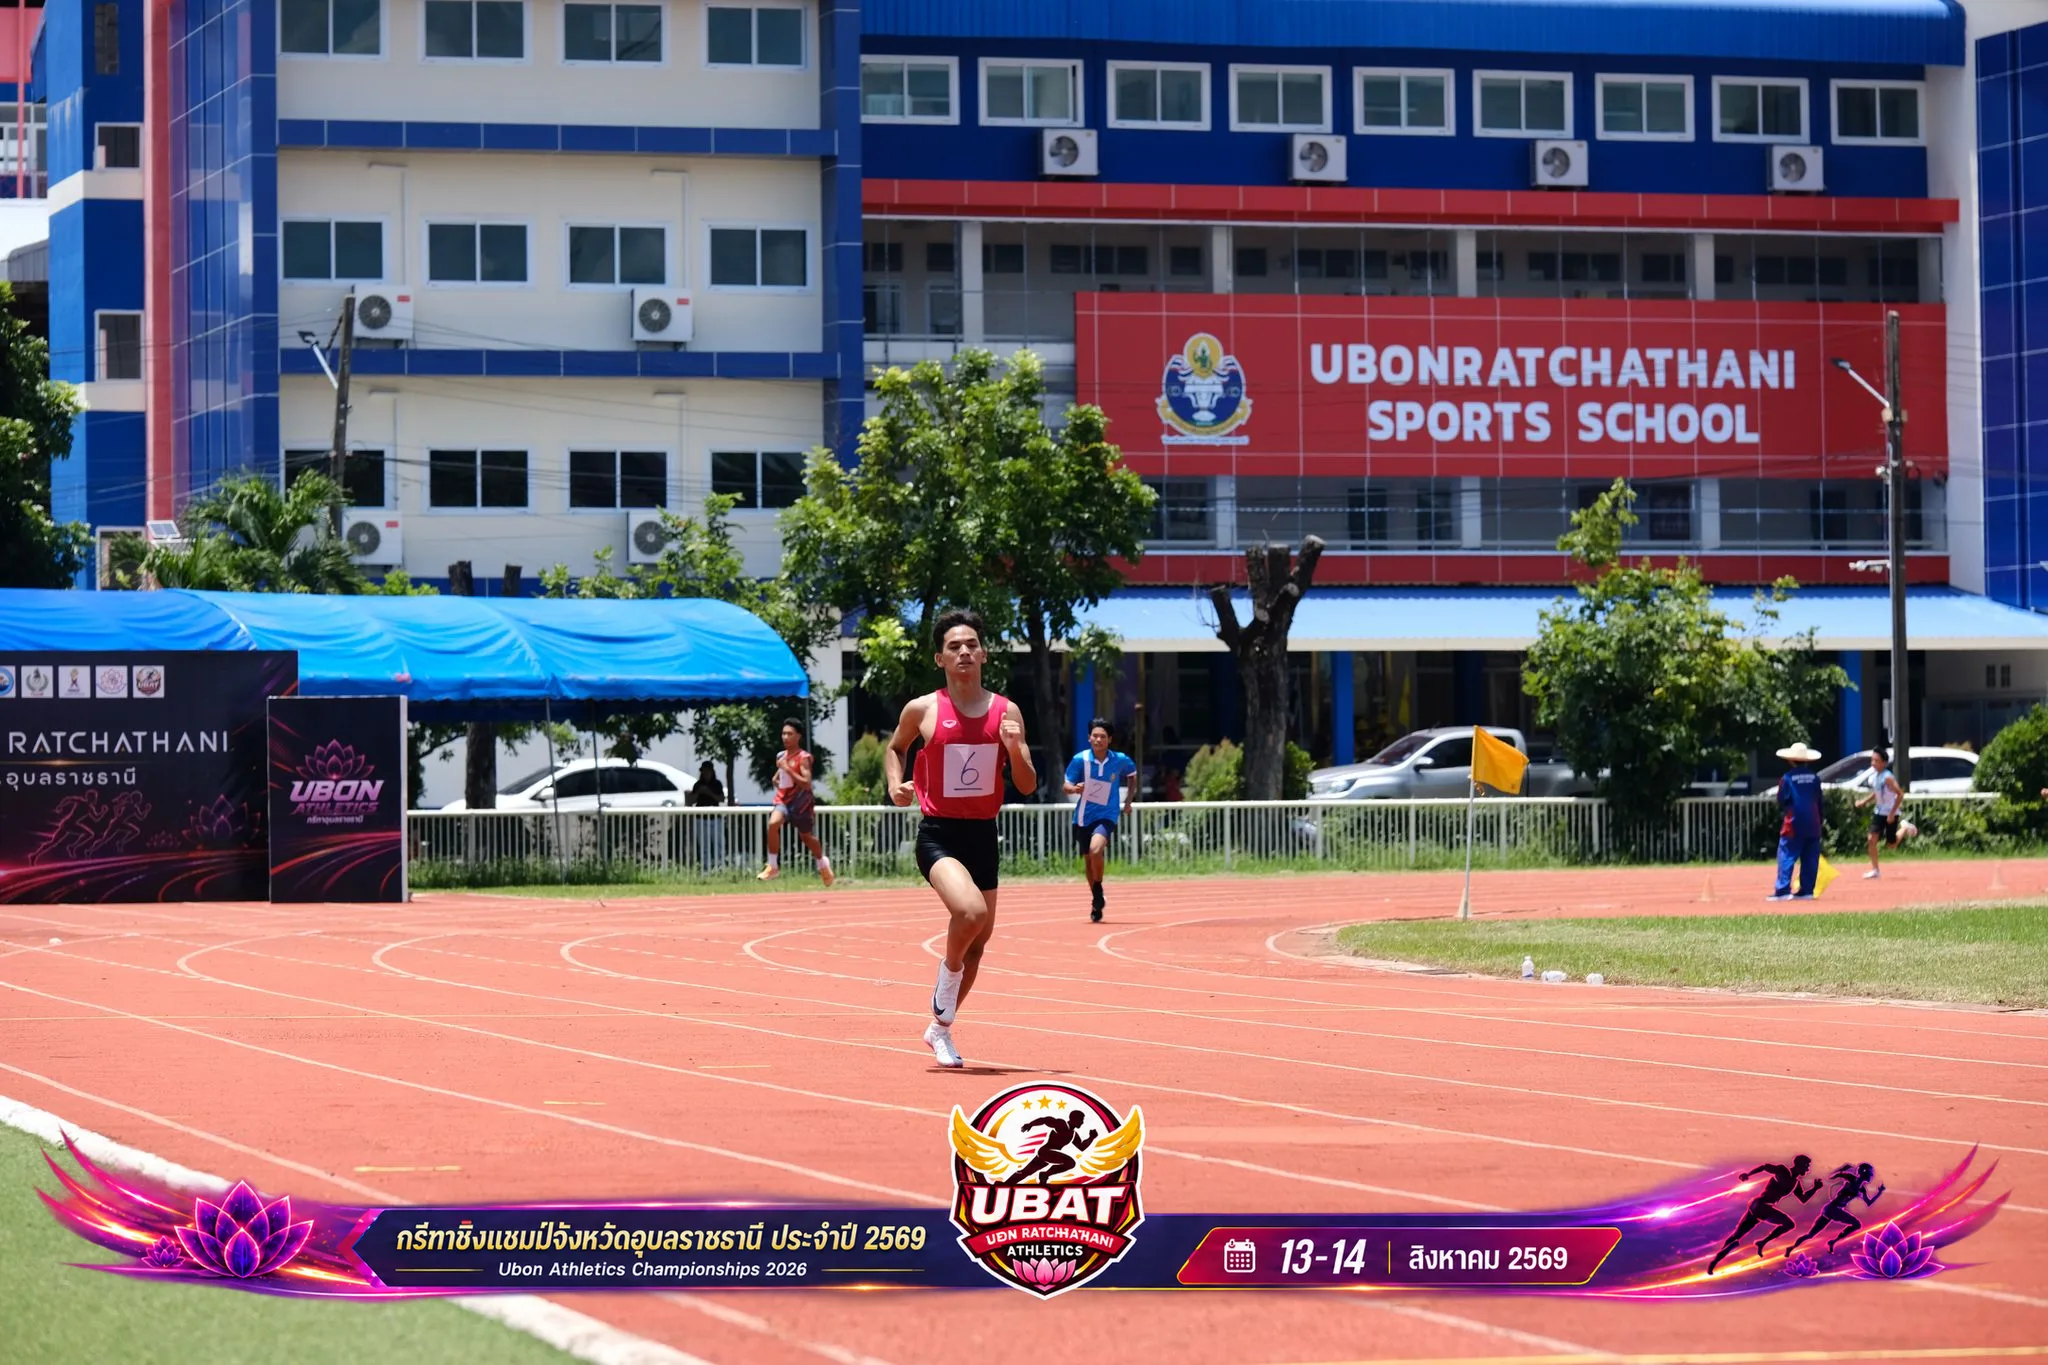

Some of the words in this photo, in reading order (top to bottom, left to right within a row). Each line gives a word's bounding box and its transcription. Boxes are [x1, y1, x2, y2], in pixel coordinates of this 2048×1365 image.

[1310, 343, 1795, 389] UBONRATCHATHANI
[1368, 400, 1551, 442] SPORTS
[1578, 402, 1760, 443] SCHOOL
[8, 731, 228, 754] RATCHATHANI
[960, 751, 980, 786] 6
[290, 780, 384, 802] UBON
[293, 802, 379, 814] ATHLETICS
